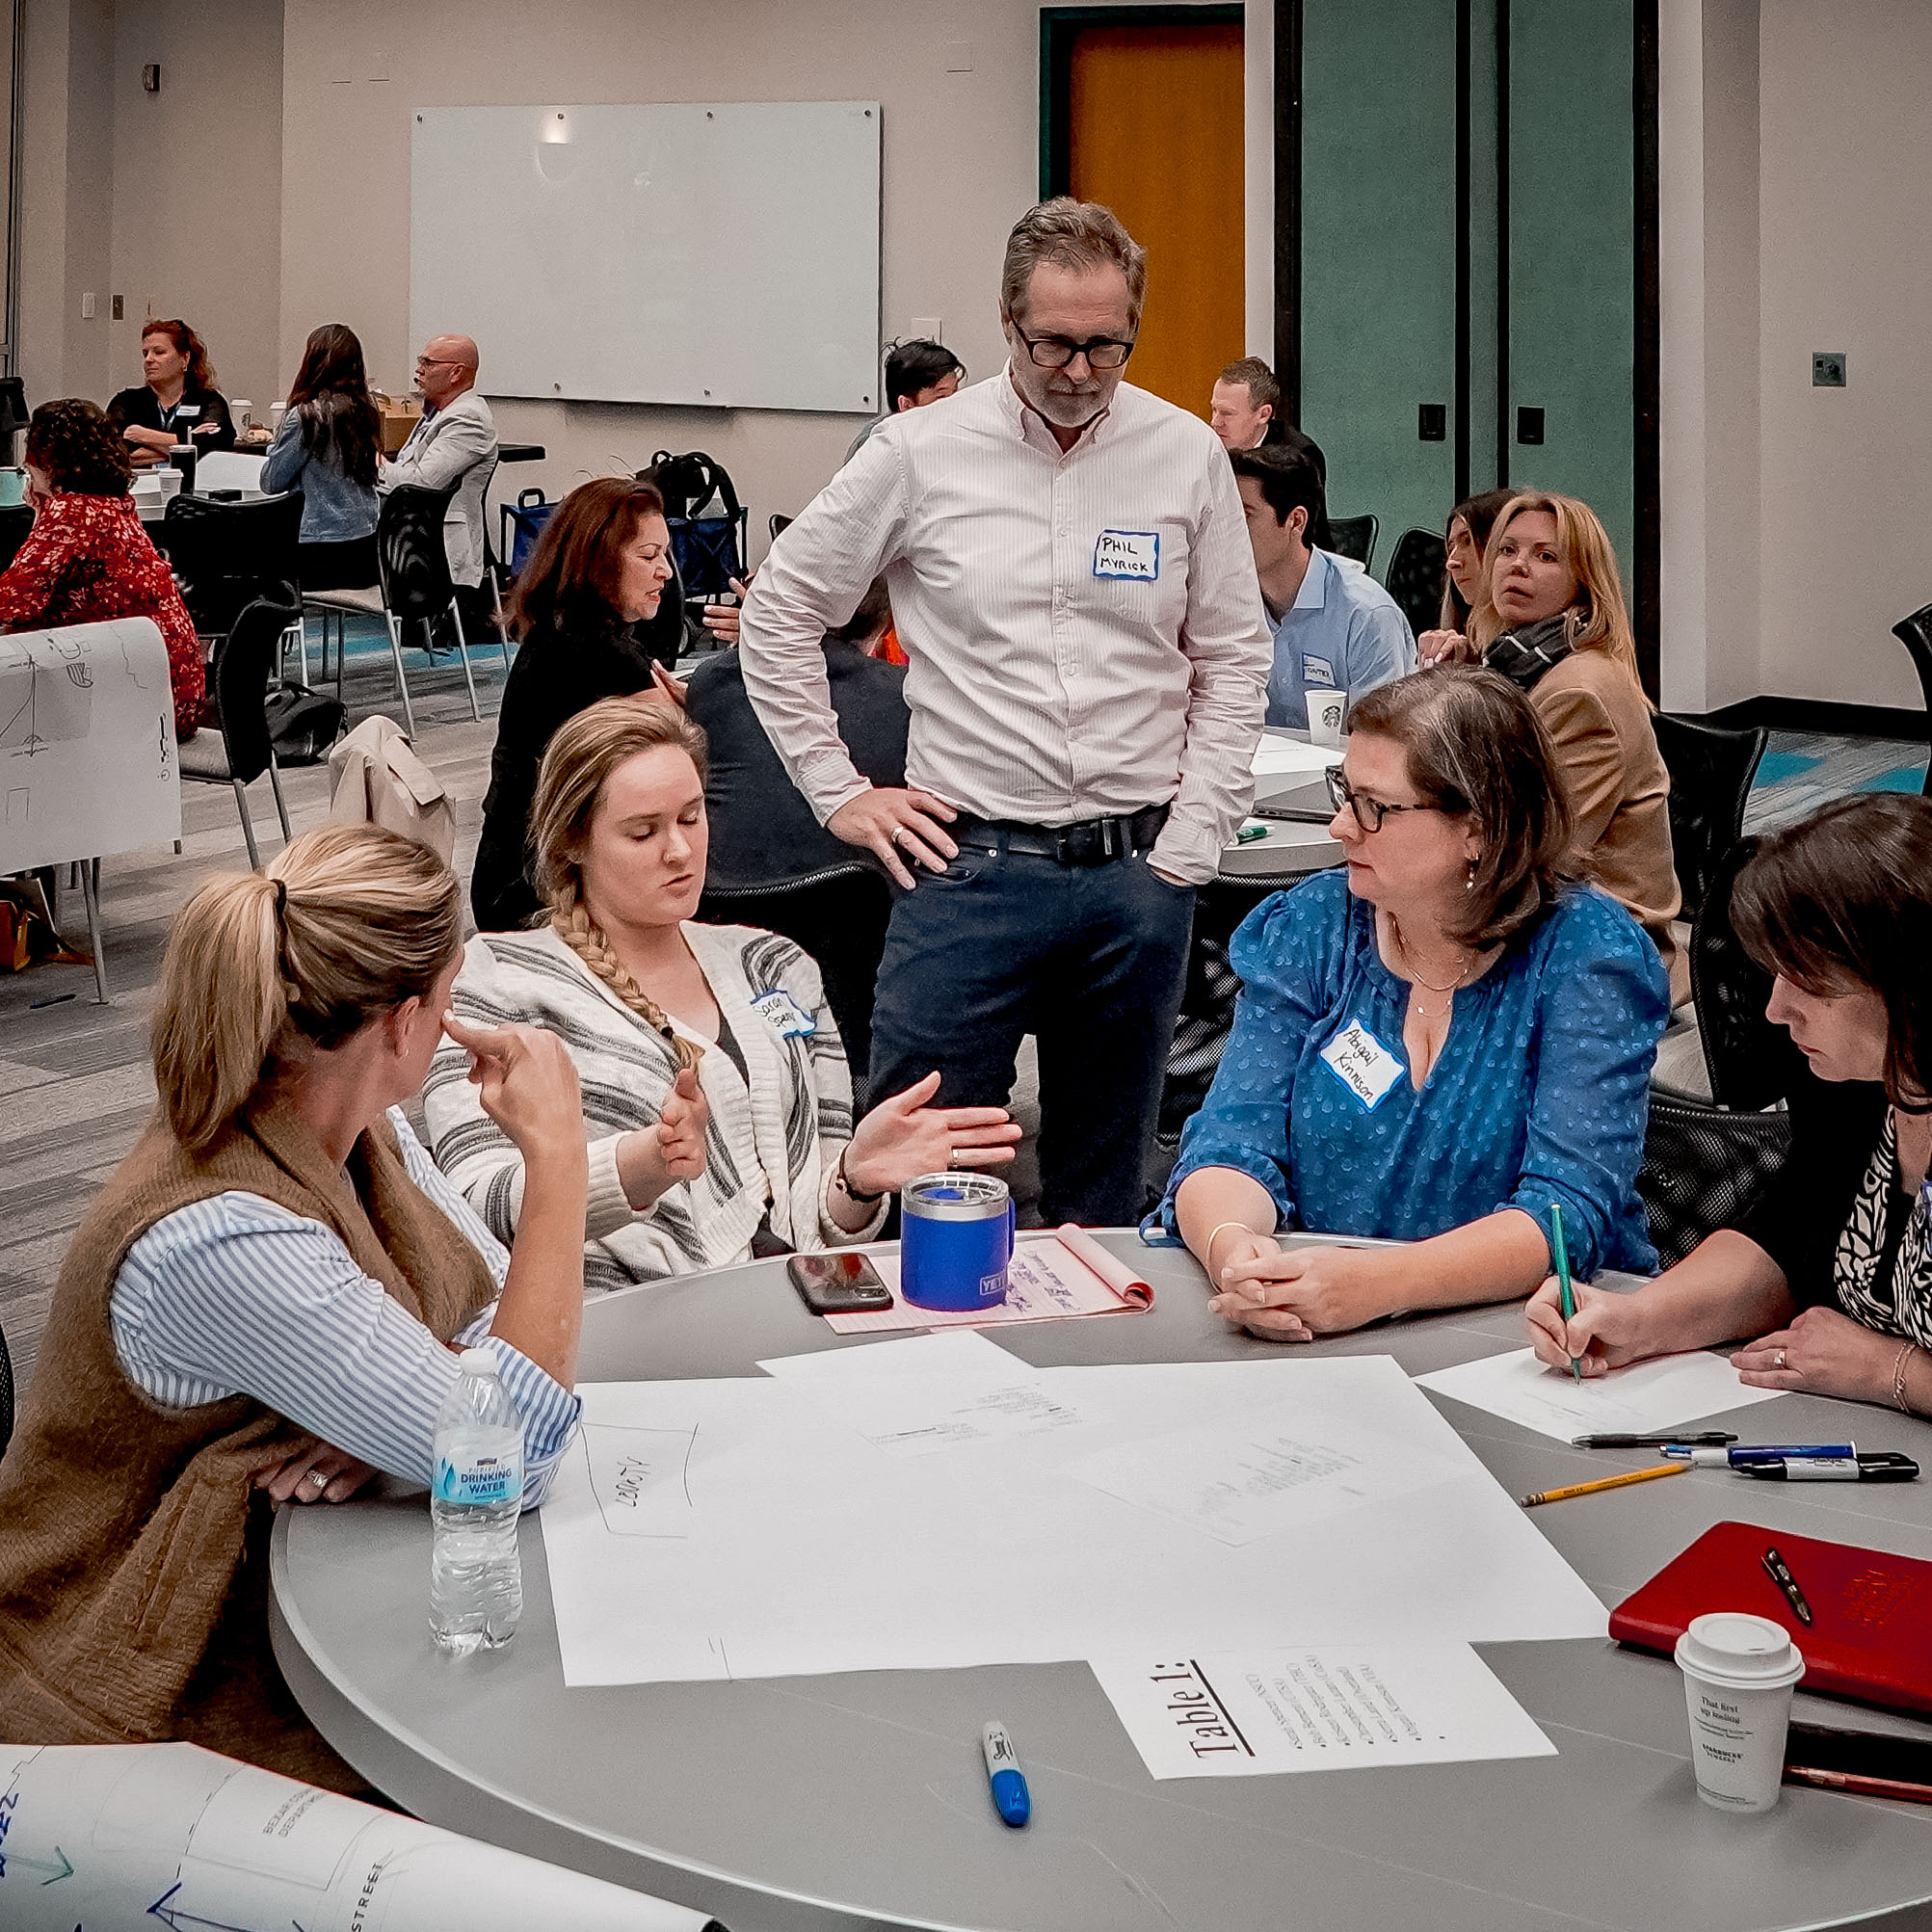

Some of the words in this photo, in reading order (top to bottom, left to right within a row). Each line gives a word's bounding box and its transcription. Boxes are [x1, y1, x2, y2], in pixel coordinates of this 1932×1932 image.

[1102, 537, 1138, 555] PHIL
[1100, 557, 1149, 572] MYRICK
[1343, 1028, 1380, 1068] Abigail
[1333, 1051, 1374, 1101] Kinnison
[461, 1468, 512, 1484] DRINKING
[468, 1481, 505, 1494] WATER
[1150, 1662, 1194, 1683] 1:
[1166, 1690, 1241, 1758] Table
[351, 1862, 383, 1932] STREET
